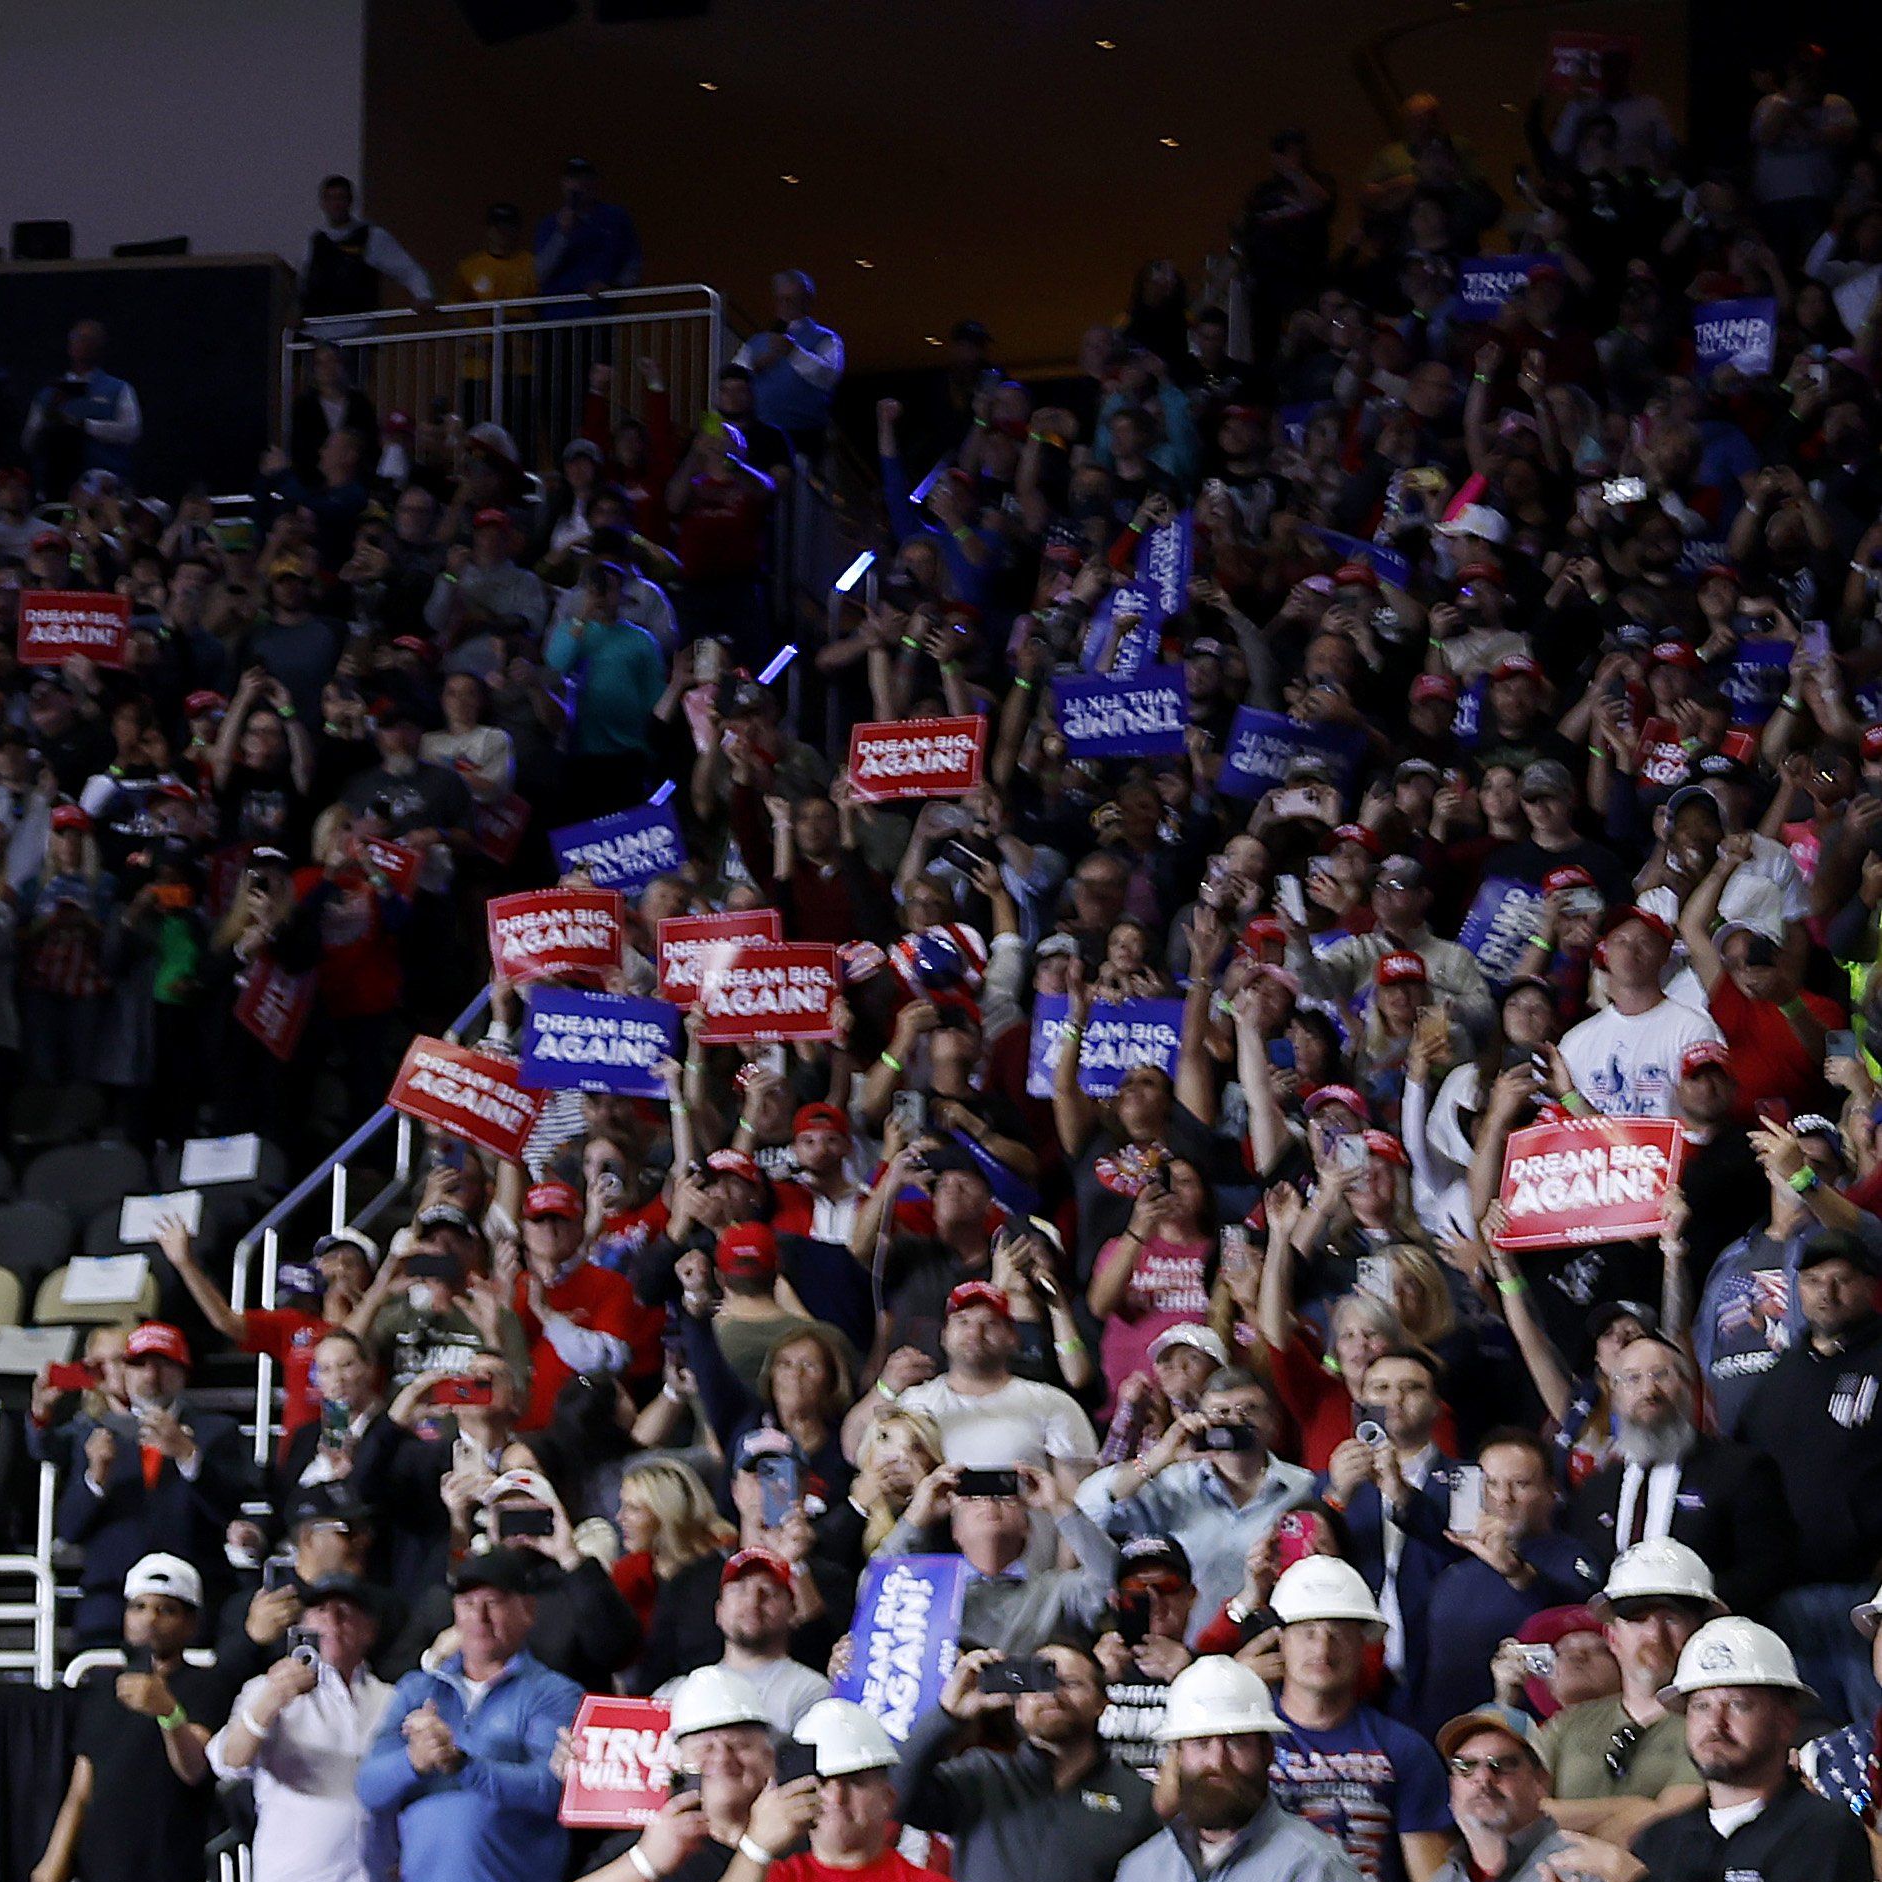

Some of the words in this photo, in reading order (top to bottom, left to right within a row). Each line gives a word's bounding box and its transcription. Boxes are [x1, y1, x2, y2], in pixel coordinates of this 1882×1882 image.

[857, 736, 933, 756] DREAM
[858, 748, 969, 778] AGAIN!
[562, 825, 676, 863] TRUMP
[497, 909, 572, 937] DREAM
[502, 925, 612, 959] AGAIN!
[706, 986, 828, 1017] AGAIN!
[532, 1013, 619, 1039] DREAM
[532, 1033, 660, 1067] AGAIN!
[414, 1051, 496, 1092] DREAM
[407, 1069, 527, 1135] AGAIN!
[1509, 1145, 1603, 1181] DREAM
[1610, 1144, 1671, 1170] BIG,
[1509, 1168, 1658, 1217] AGAIN!
[859, 1631, 896, 1718] REAM
[879, 1579, 935, 1742] AGAIN!
[582, 1726, 673, 1770] TRU
[578, 1761, 646, 1792] WILL
